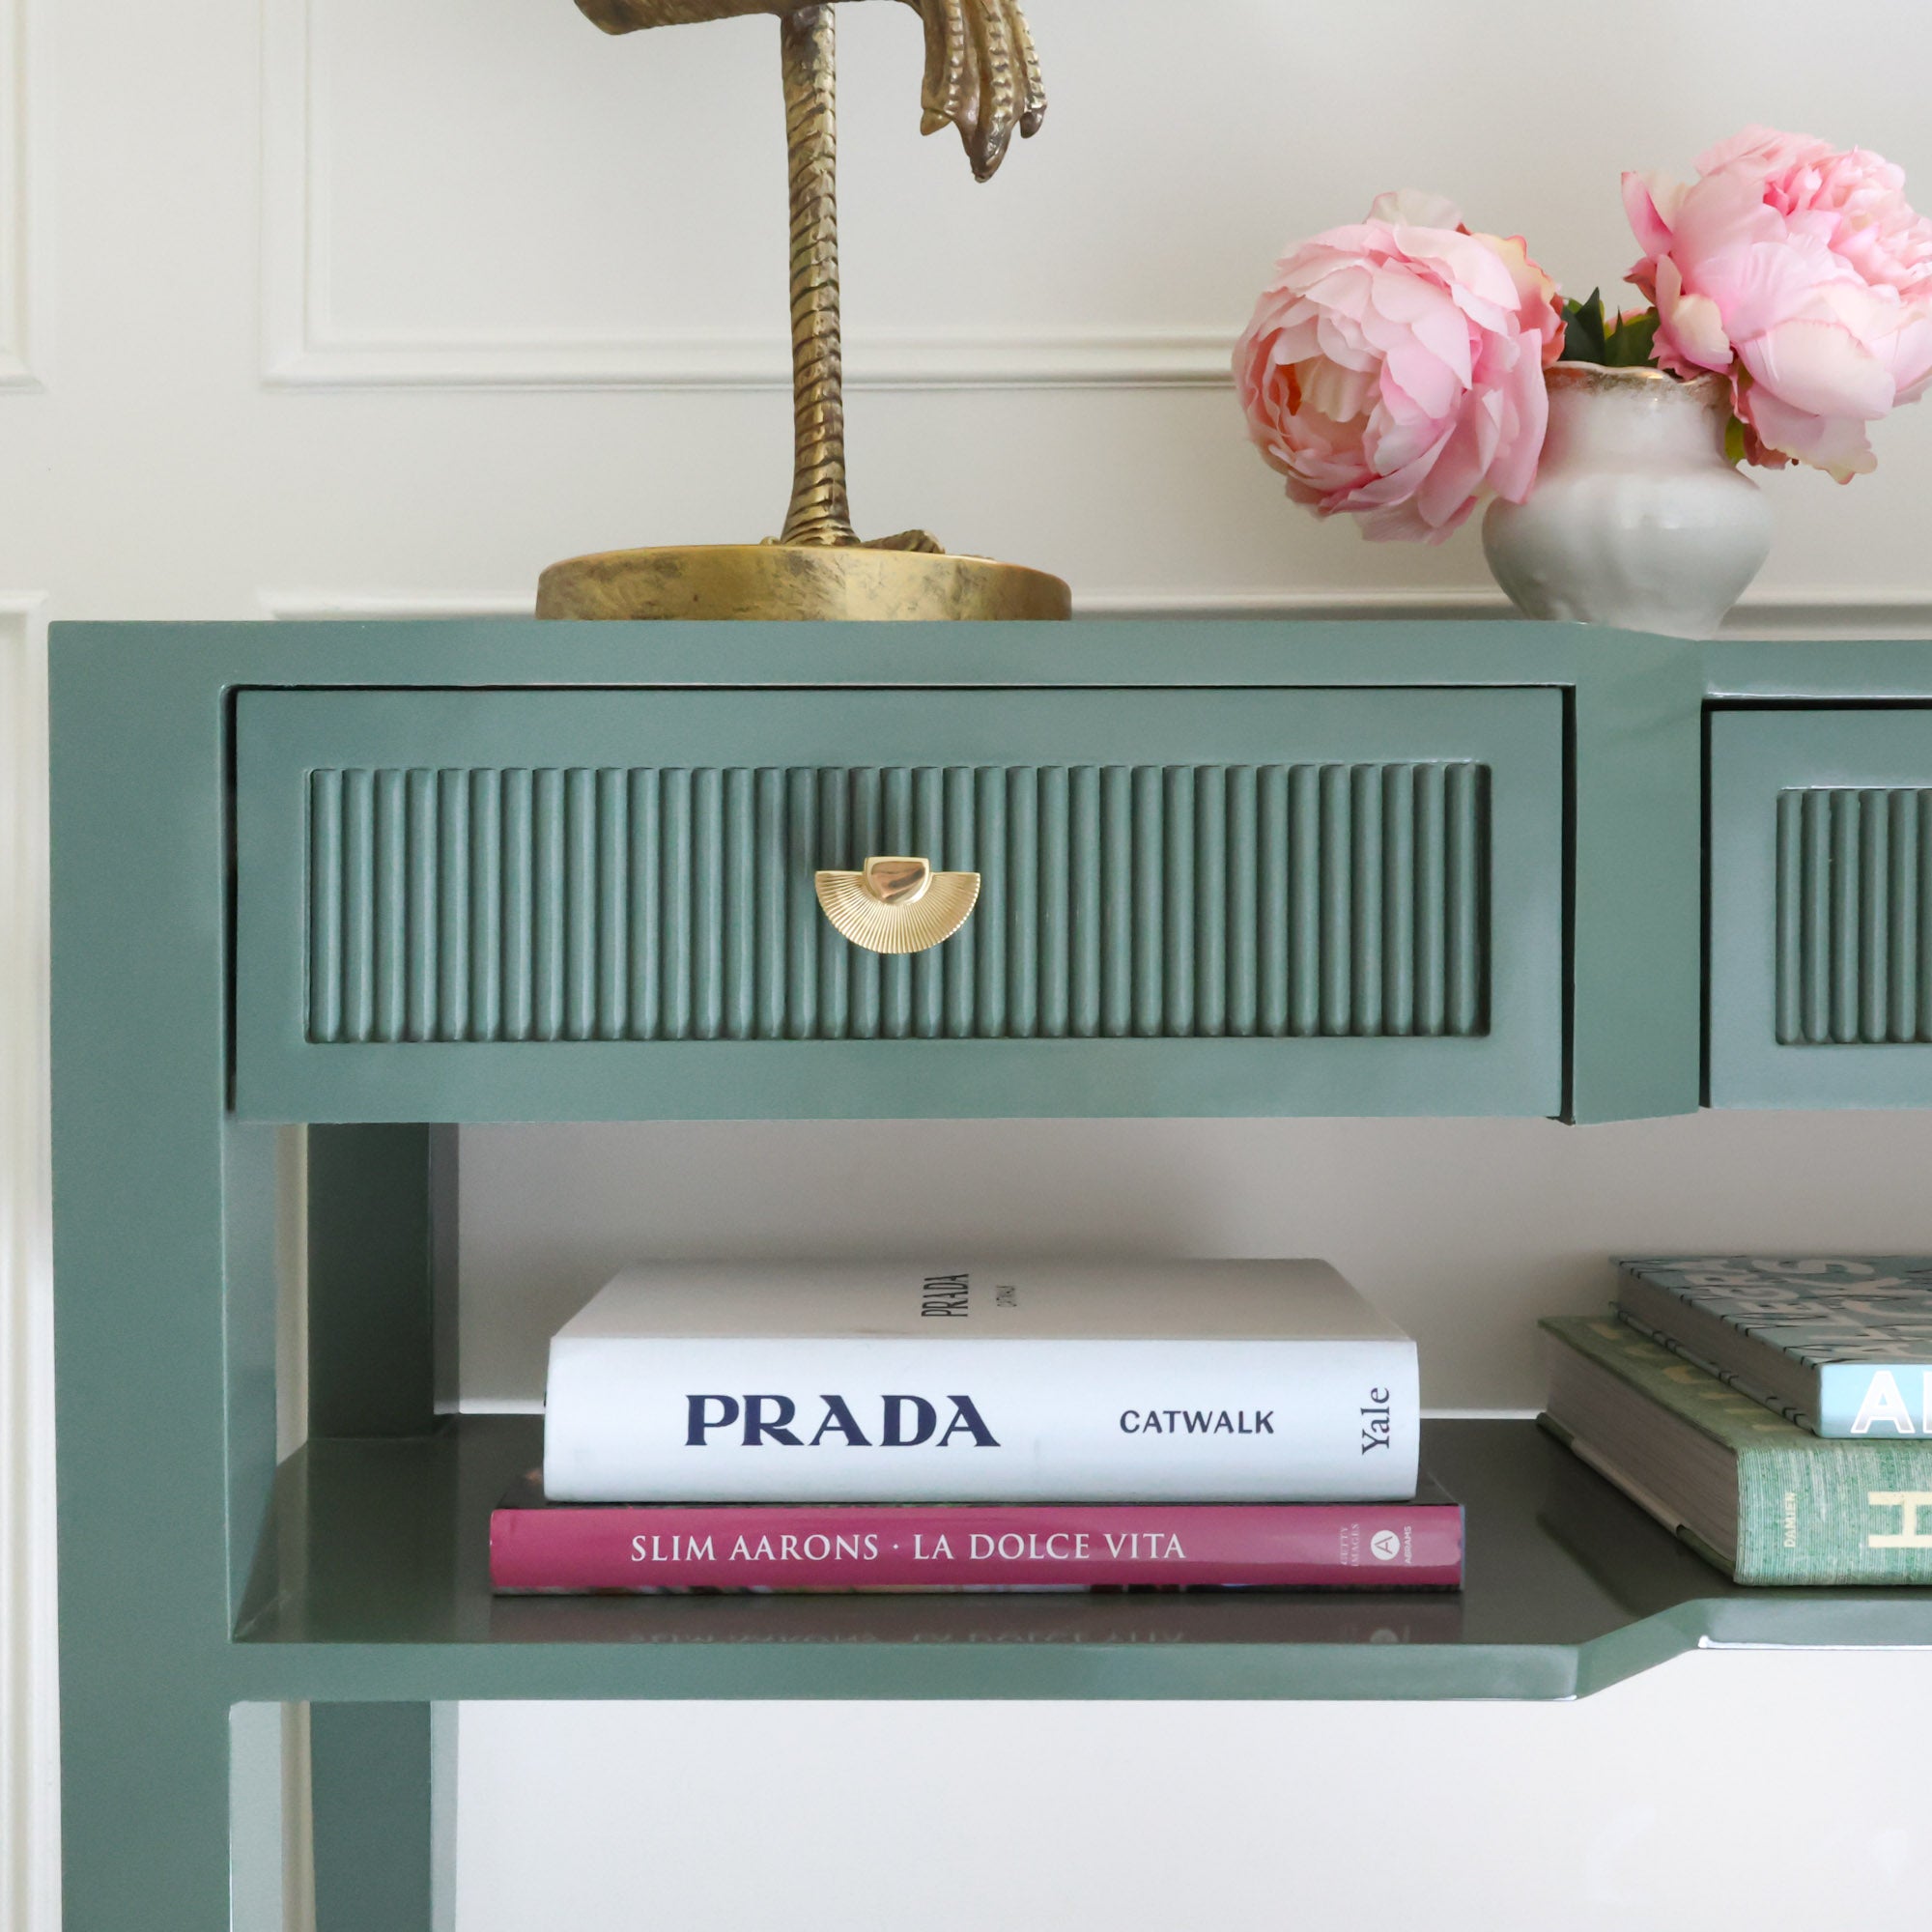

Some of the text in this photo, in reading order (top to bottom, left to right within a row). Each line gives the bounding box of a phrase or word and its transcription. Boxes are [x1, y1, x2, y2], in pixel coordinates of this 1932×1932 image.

[921, 1273, 969, 1317] PRADA
[685, 1395, 1274, 1446] PRADA CATWALK
[1361, 1387, 1390, 1455] Yale
[1850, 1370, 1932, 1434] A
[1783, 1491, 1797, 1548] DAMIEN
[632, 1533, 1186, 1561] SLIM AARONS LA DOLCE VITA
[1372, 1533, 1395, 1556] A
[1404, 1525, 1412, 1564] ABRAMS
